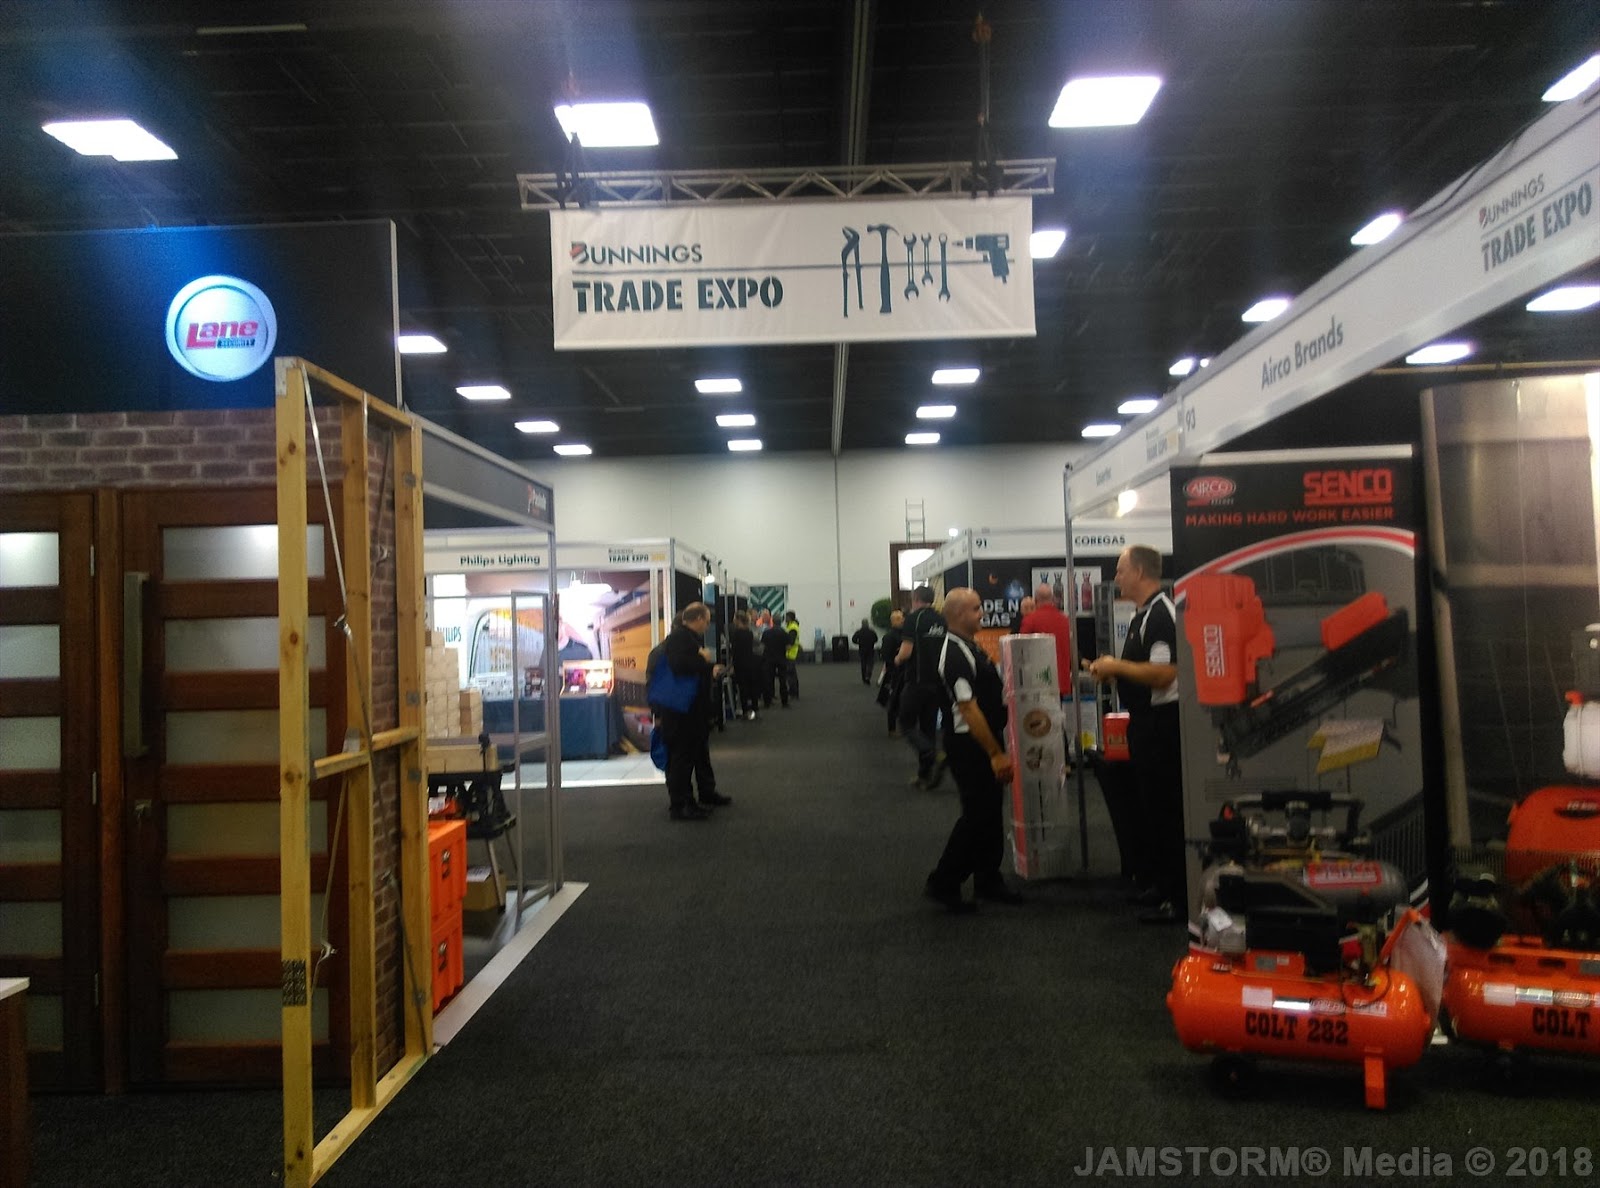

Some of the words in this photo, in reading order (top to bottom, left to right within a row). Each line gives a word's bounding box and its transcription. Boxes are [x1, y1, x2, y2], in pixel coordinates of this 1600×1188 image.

[1479, 173, 1545, 229] BUNNINGS
[1481, 213, 1536, 272] TRADE
[1542, 181, 1592, 239] EXPO
[569, 242, 703, 264] BUNNINGS
[572, 279, 683, 313] TRADE
[697, 276, 784, 309] EXPO
[186, 321, 259, 350] Lane
[1261, 355, 1291, 391] Airco
[1294, 314, 1343, 370] Brands
[1185, 407, 1196, 431] 93
[1188, 480, 1230, 497] AIRCO
[1303, 468, 1393, 498] SENCO
[1185, 511, 1242, 527] MAKING
[1247, 510, 1287, 525] HARD
[1291, 508, 1336, 523] WORK
[1342, 505, 1393, 521] EASIER
[975, 538, 988, 548] 91
[459, 555, 495, 567] Philips
[499, 552, 541, 565] Lighting
[1245, 1011, 1299, 1041] COLT
[1306, 1017, 1349, 1045] 282
[1532, 1006, 1591, 1038] COLT
